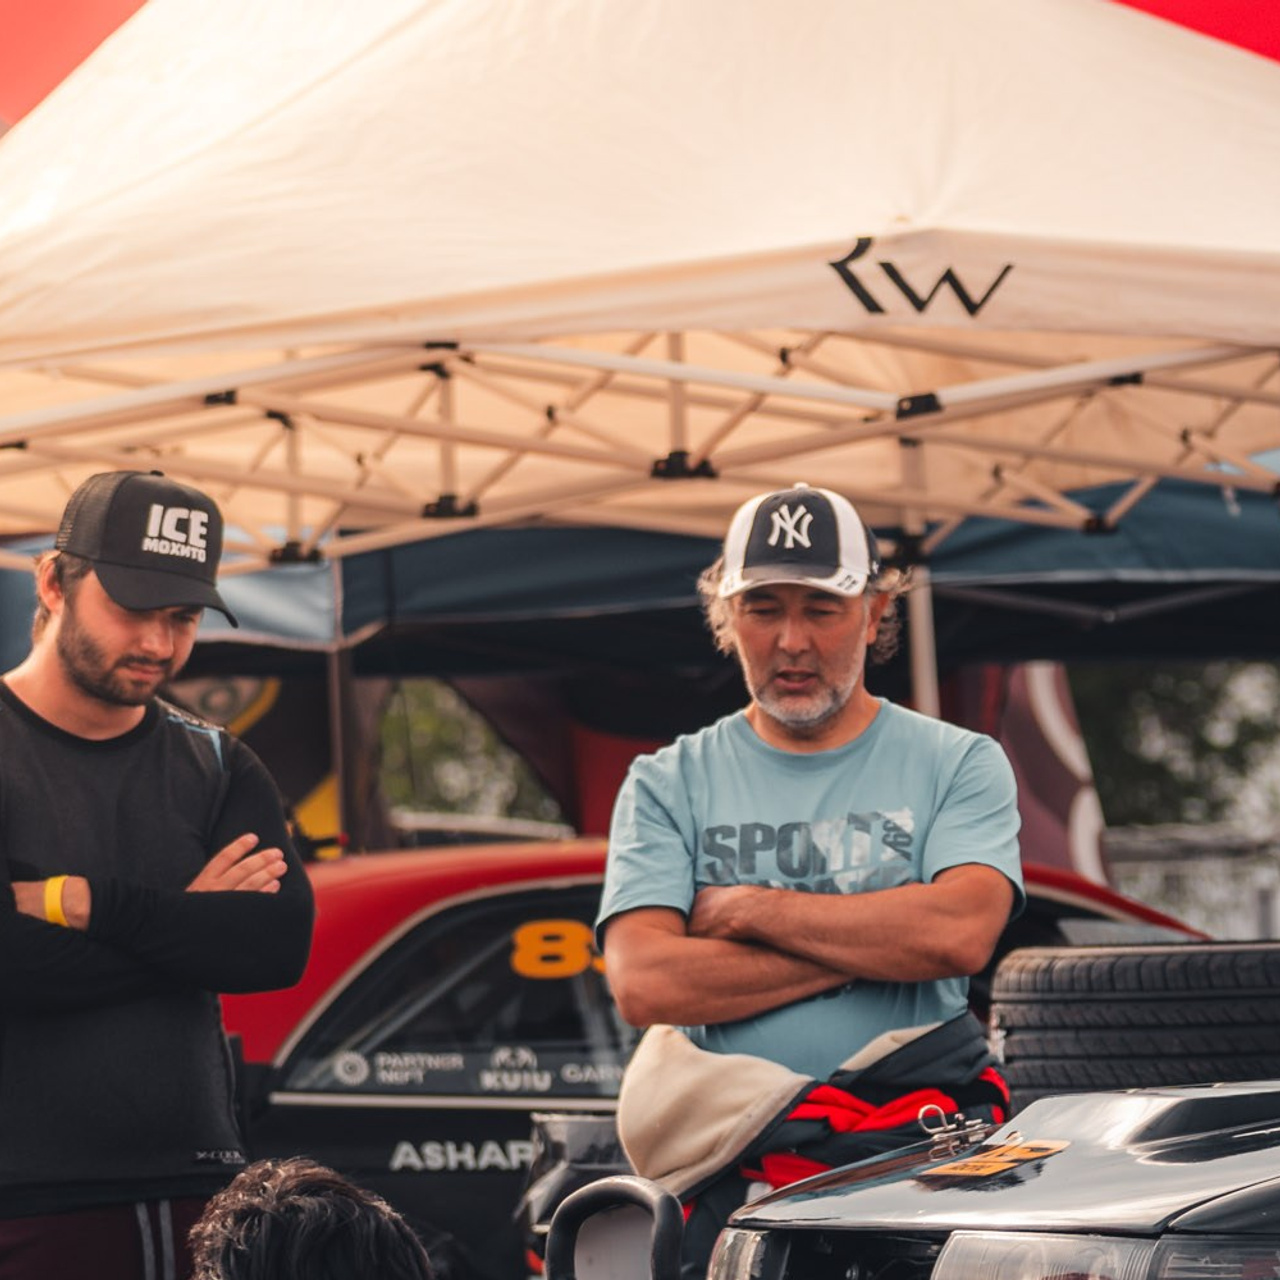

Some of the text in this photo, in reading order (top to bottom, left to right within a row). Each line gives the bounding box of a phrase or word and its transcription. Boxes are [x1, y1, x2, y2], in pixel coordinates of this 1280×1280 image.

[147, 503, 209, 549] ICE
[767, 503, 814, 549] NY
[142, 537, 207, 563] МОХИТО
[510, 919, 606, 978] 8
